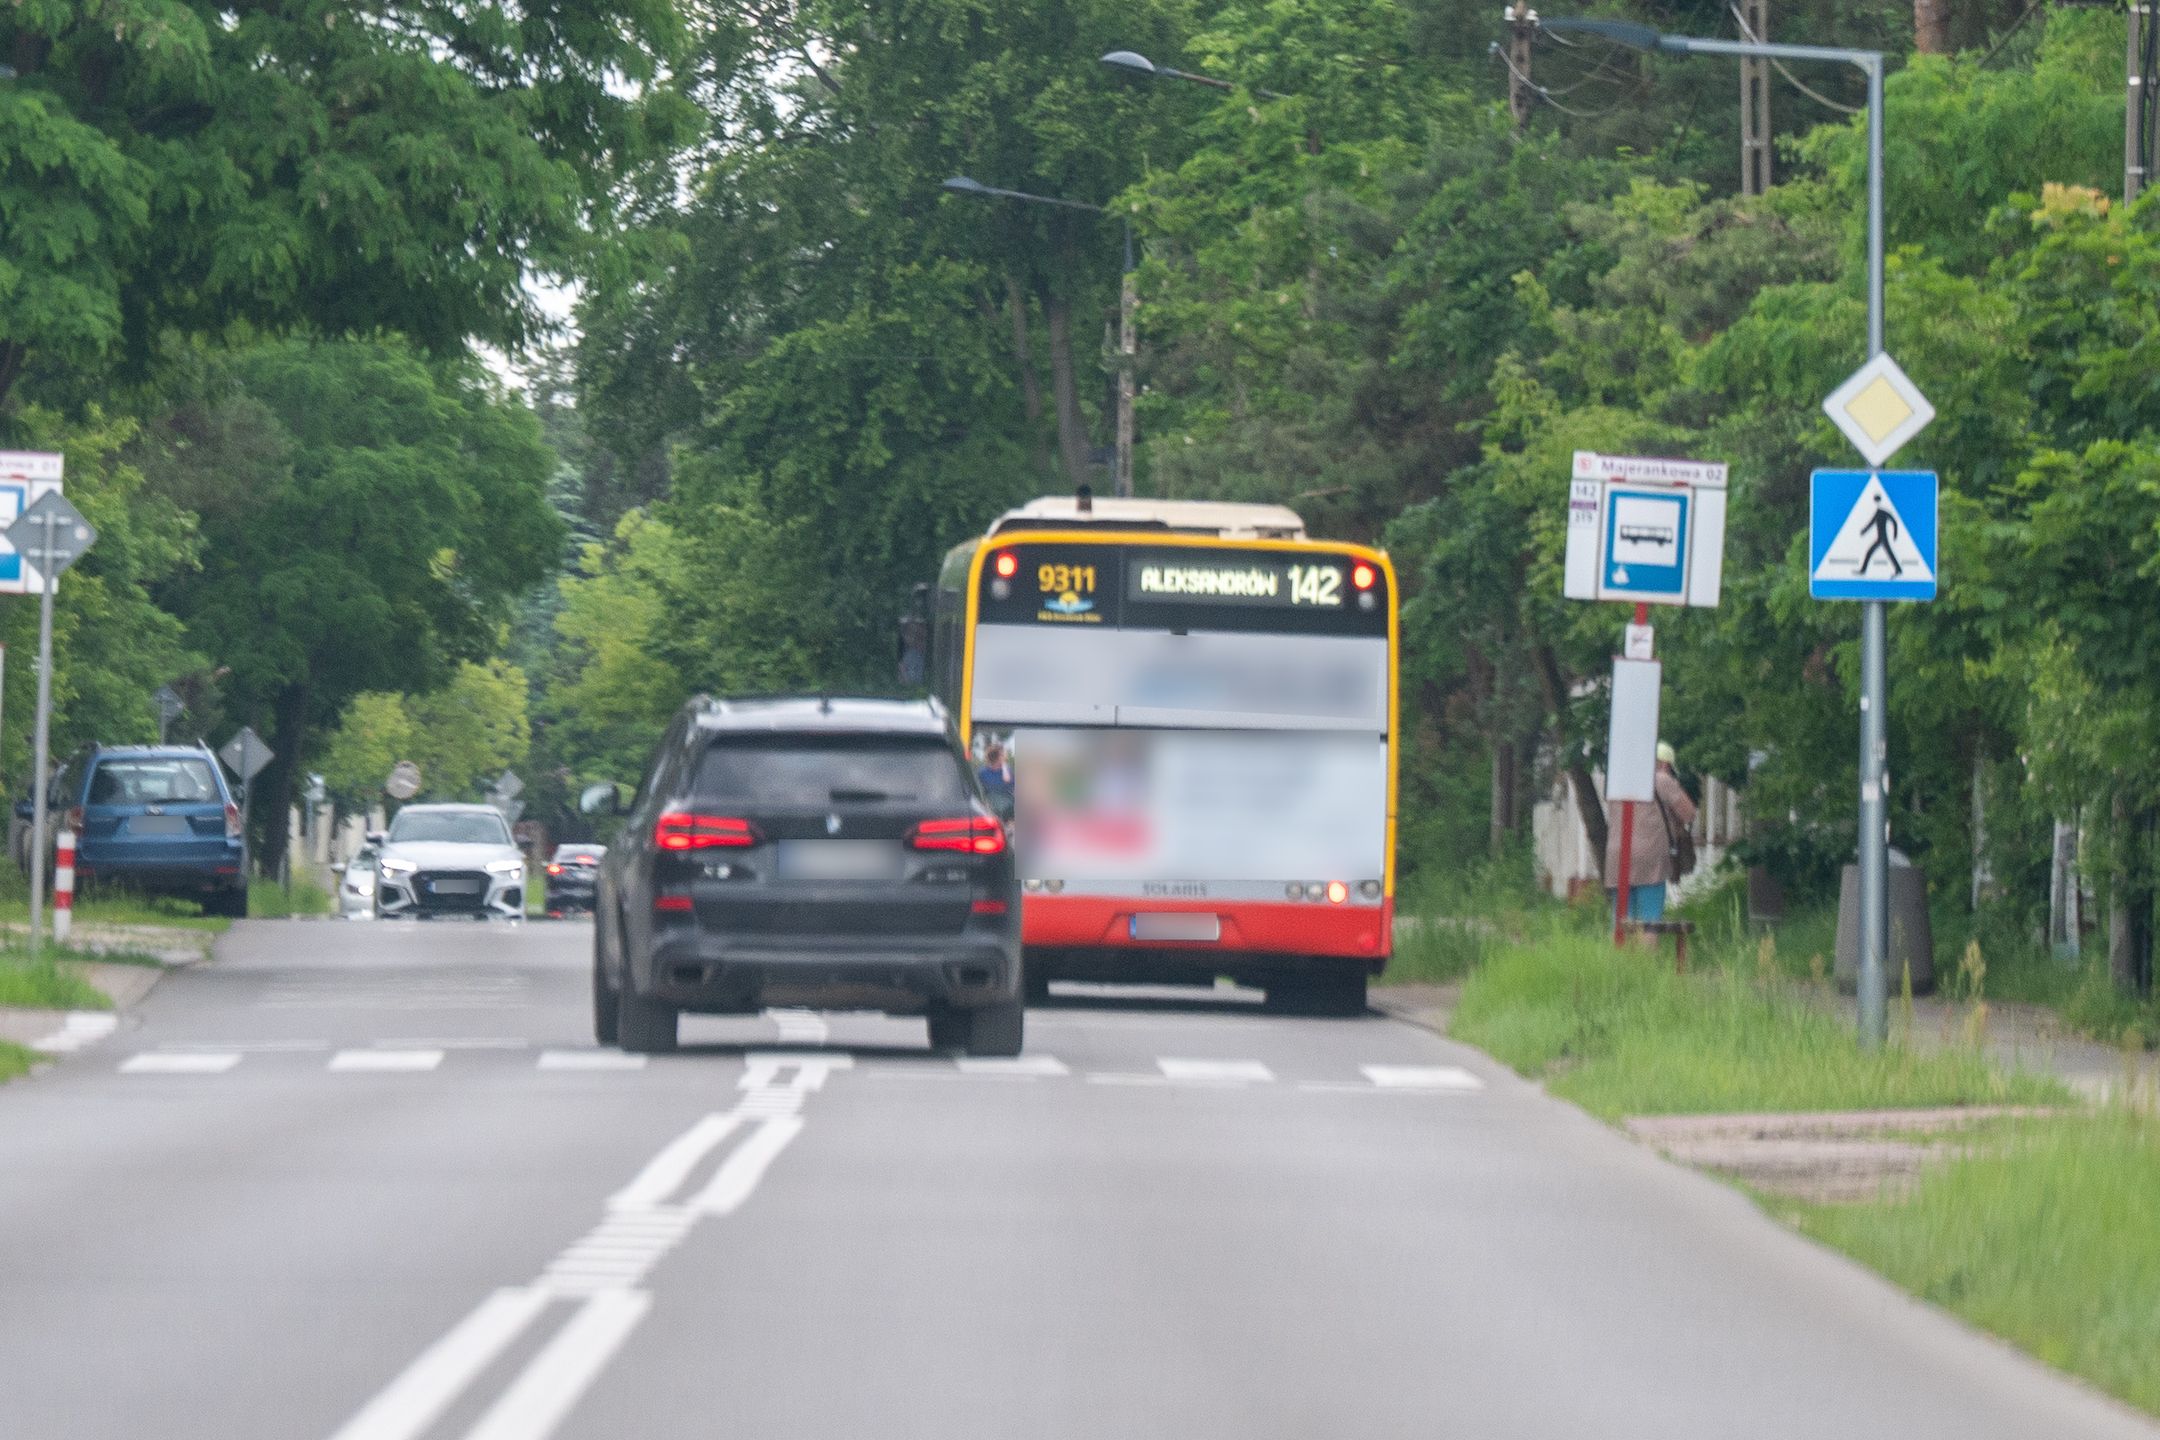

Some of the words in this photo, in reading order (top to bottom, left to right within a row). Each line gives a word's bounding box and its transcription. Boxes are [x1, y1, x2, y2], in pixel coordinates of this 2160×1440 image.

[1705, 468, 1723, 480] 02
[1038, 563, 1096, 593] 9311
[1288, 564, 1342, 605] 142
